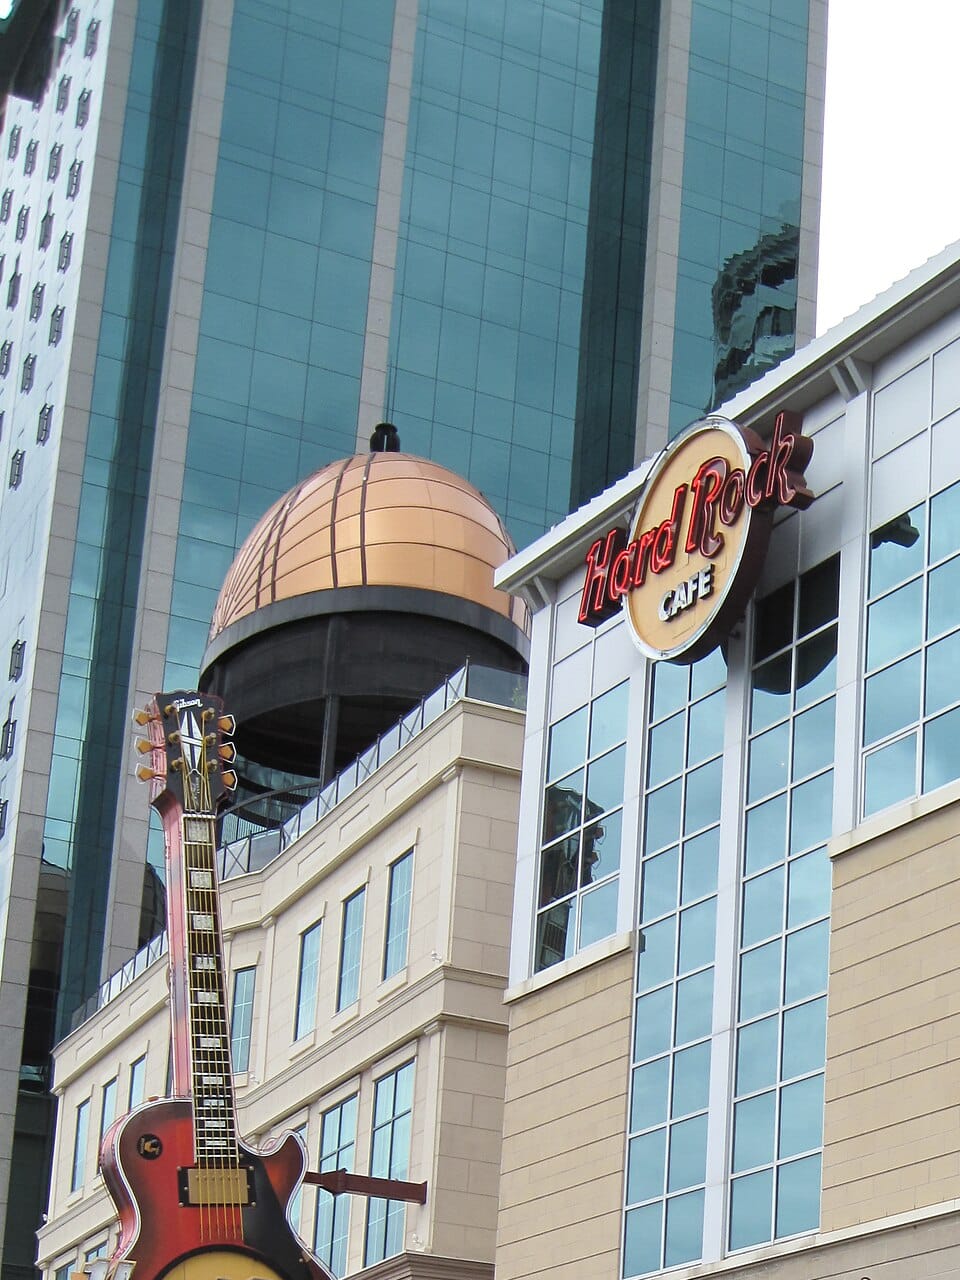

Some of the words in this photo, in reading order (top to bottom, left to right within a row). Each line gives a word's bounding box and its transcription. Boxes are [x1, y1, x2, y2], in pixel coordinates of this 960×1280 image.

[578, 484, 688, 624] Hard
[685, 411, 800, 558] Rock
[657, 564, 715, 621] CAFE
[174, 699, 203, 712] Gibson
